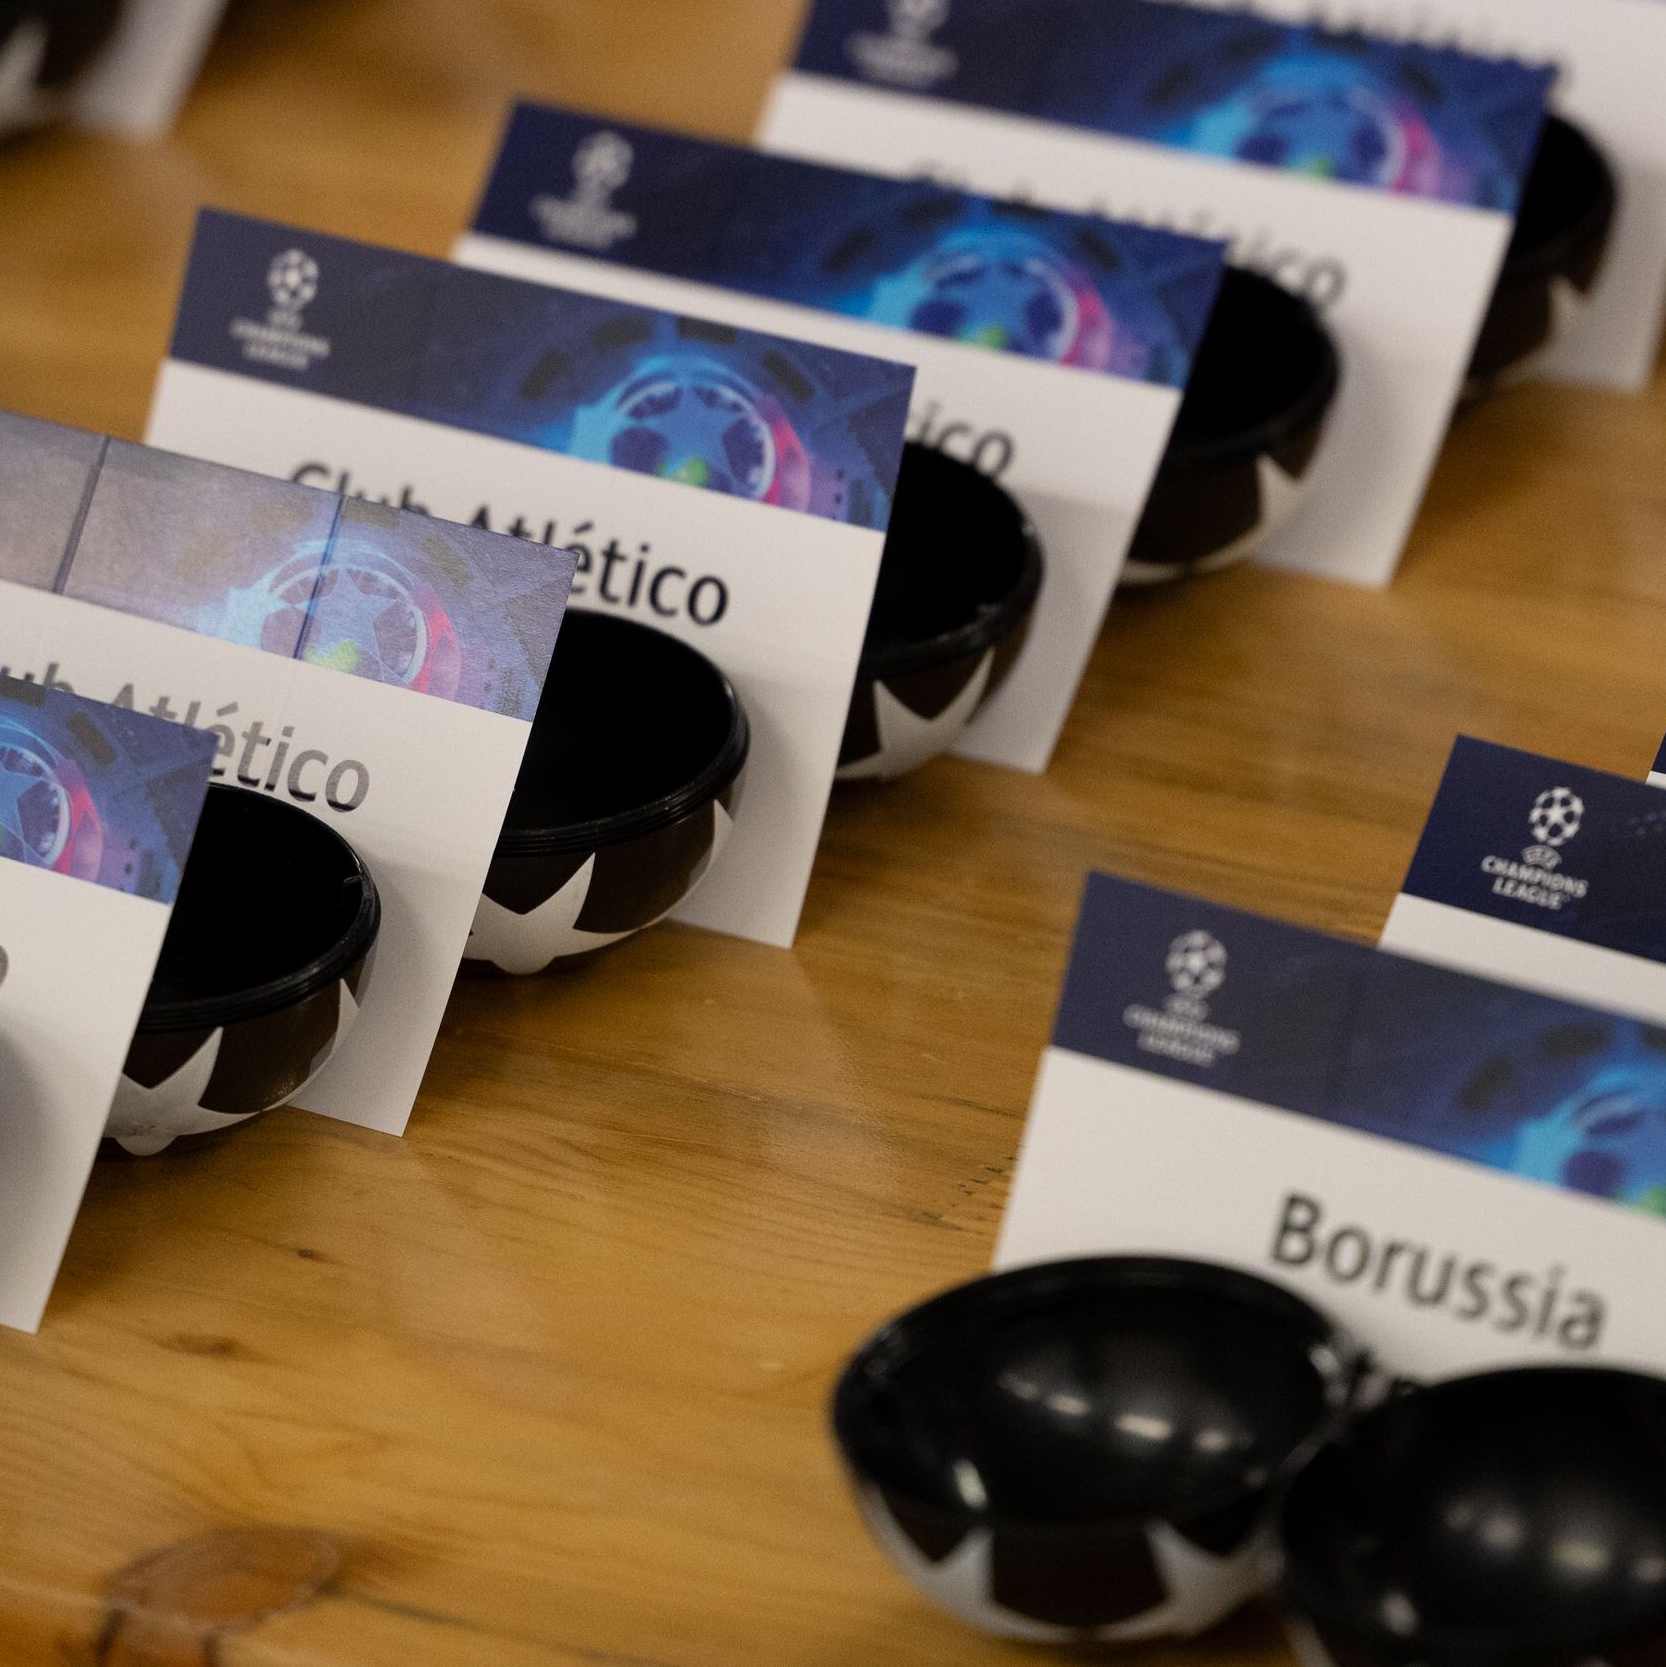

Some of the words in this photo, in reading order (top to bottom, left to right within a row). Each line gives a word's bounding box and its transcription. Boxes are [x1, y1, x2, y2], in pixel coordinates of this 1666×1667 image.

[1480, 854, 1589, 899] CHAMPIONS
[1492, 875, 1562, 910] LEAGUE
[1270, 1191, 1609, 1351] Borussia
